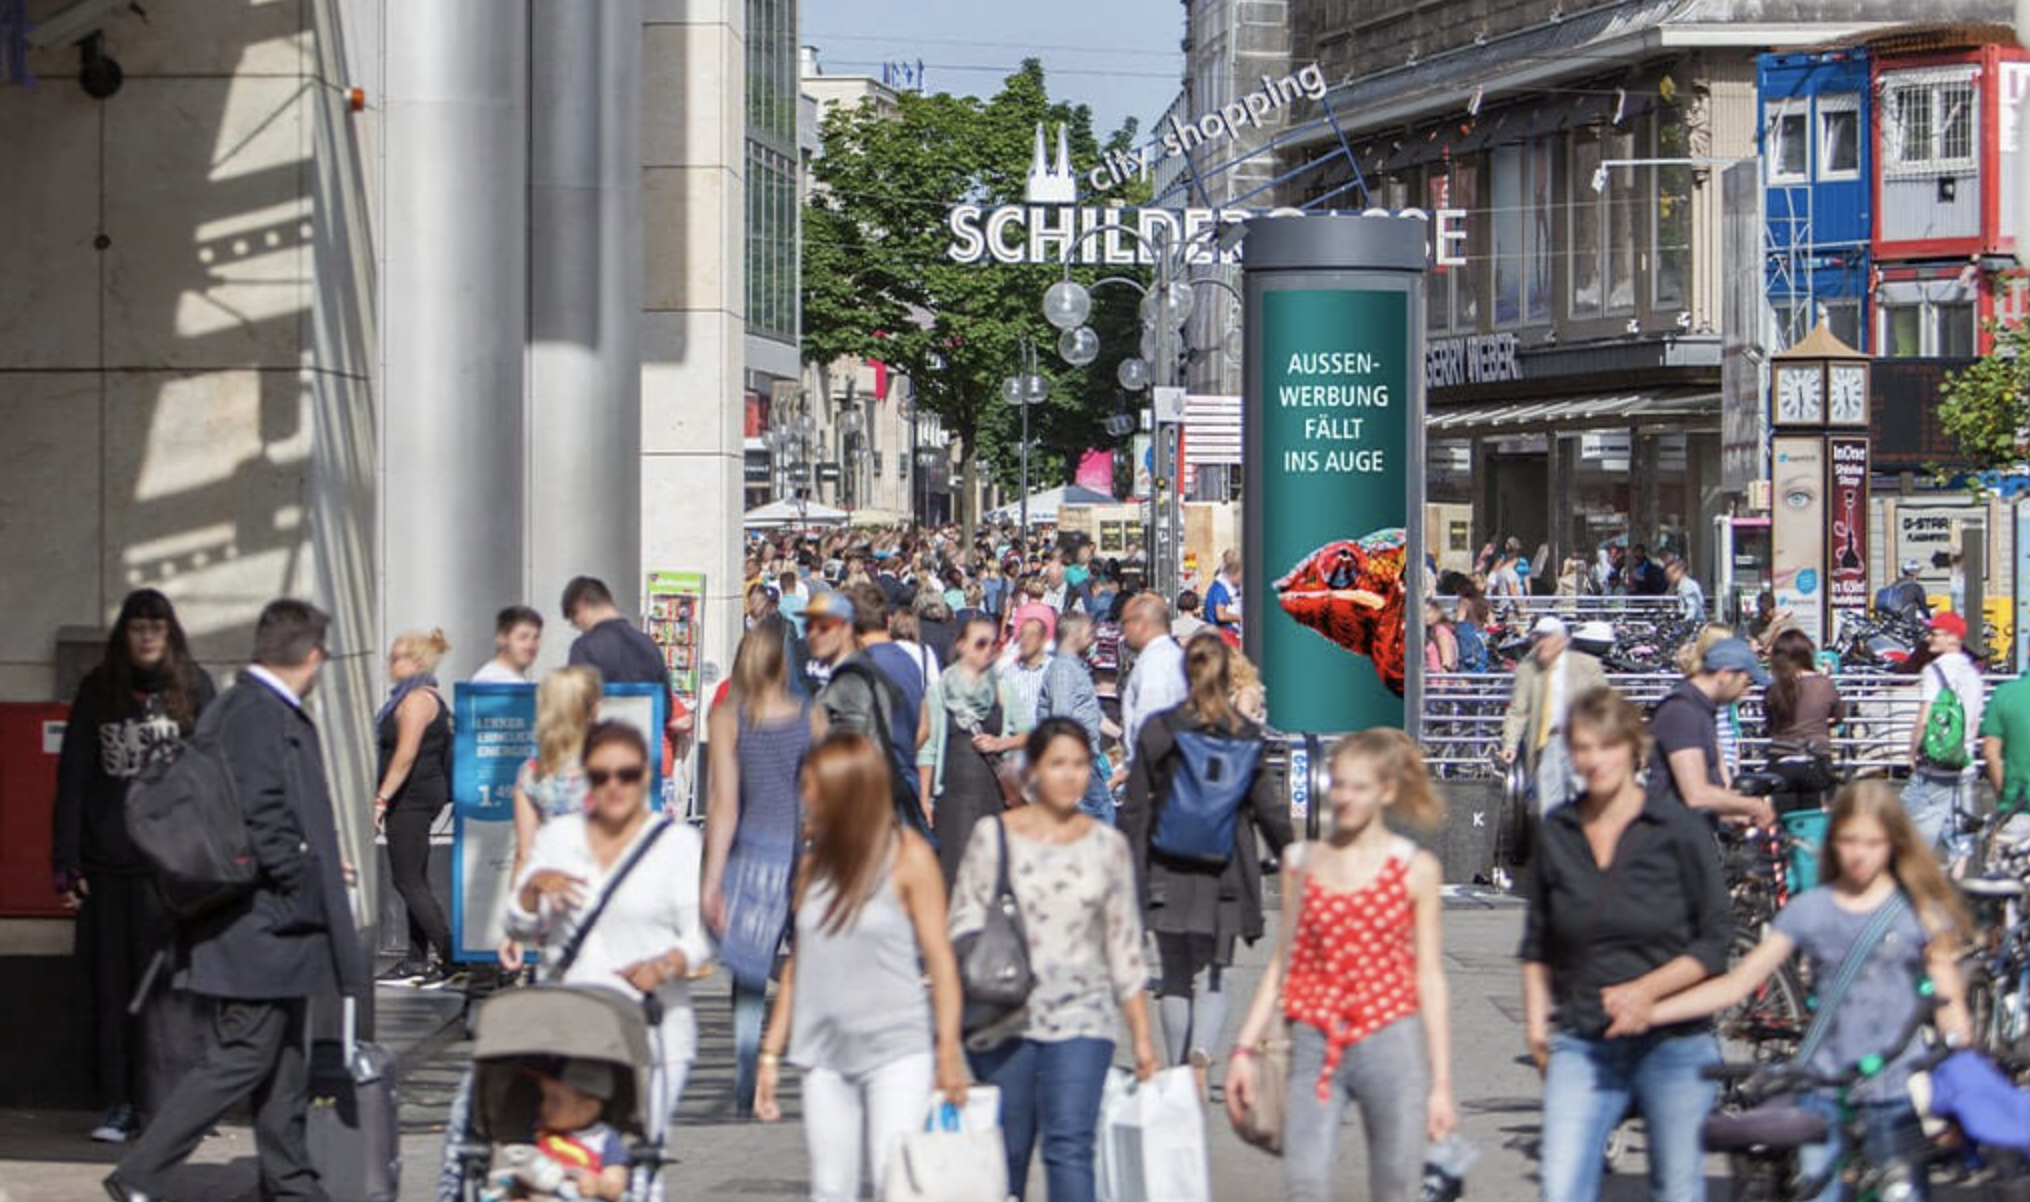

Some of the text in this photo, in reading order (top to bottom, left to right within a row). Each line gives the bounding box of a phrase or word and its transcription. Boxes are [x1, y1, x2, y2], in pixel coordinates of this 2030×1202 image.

[1090, 61, 1327, 192] city shopping
[1287, 352, 1381, 375] AUSSEN-
[1467, 332, 1519, 383] WEBER
[1279, 385, 1389, 407] WERBUNG
[1304, 413, 1364, 439] FÄLLT
[1284, 451, 1384, 472] INS AUGE
[1473, 811, 1485, 827] K
